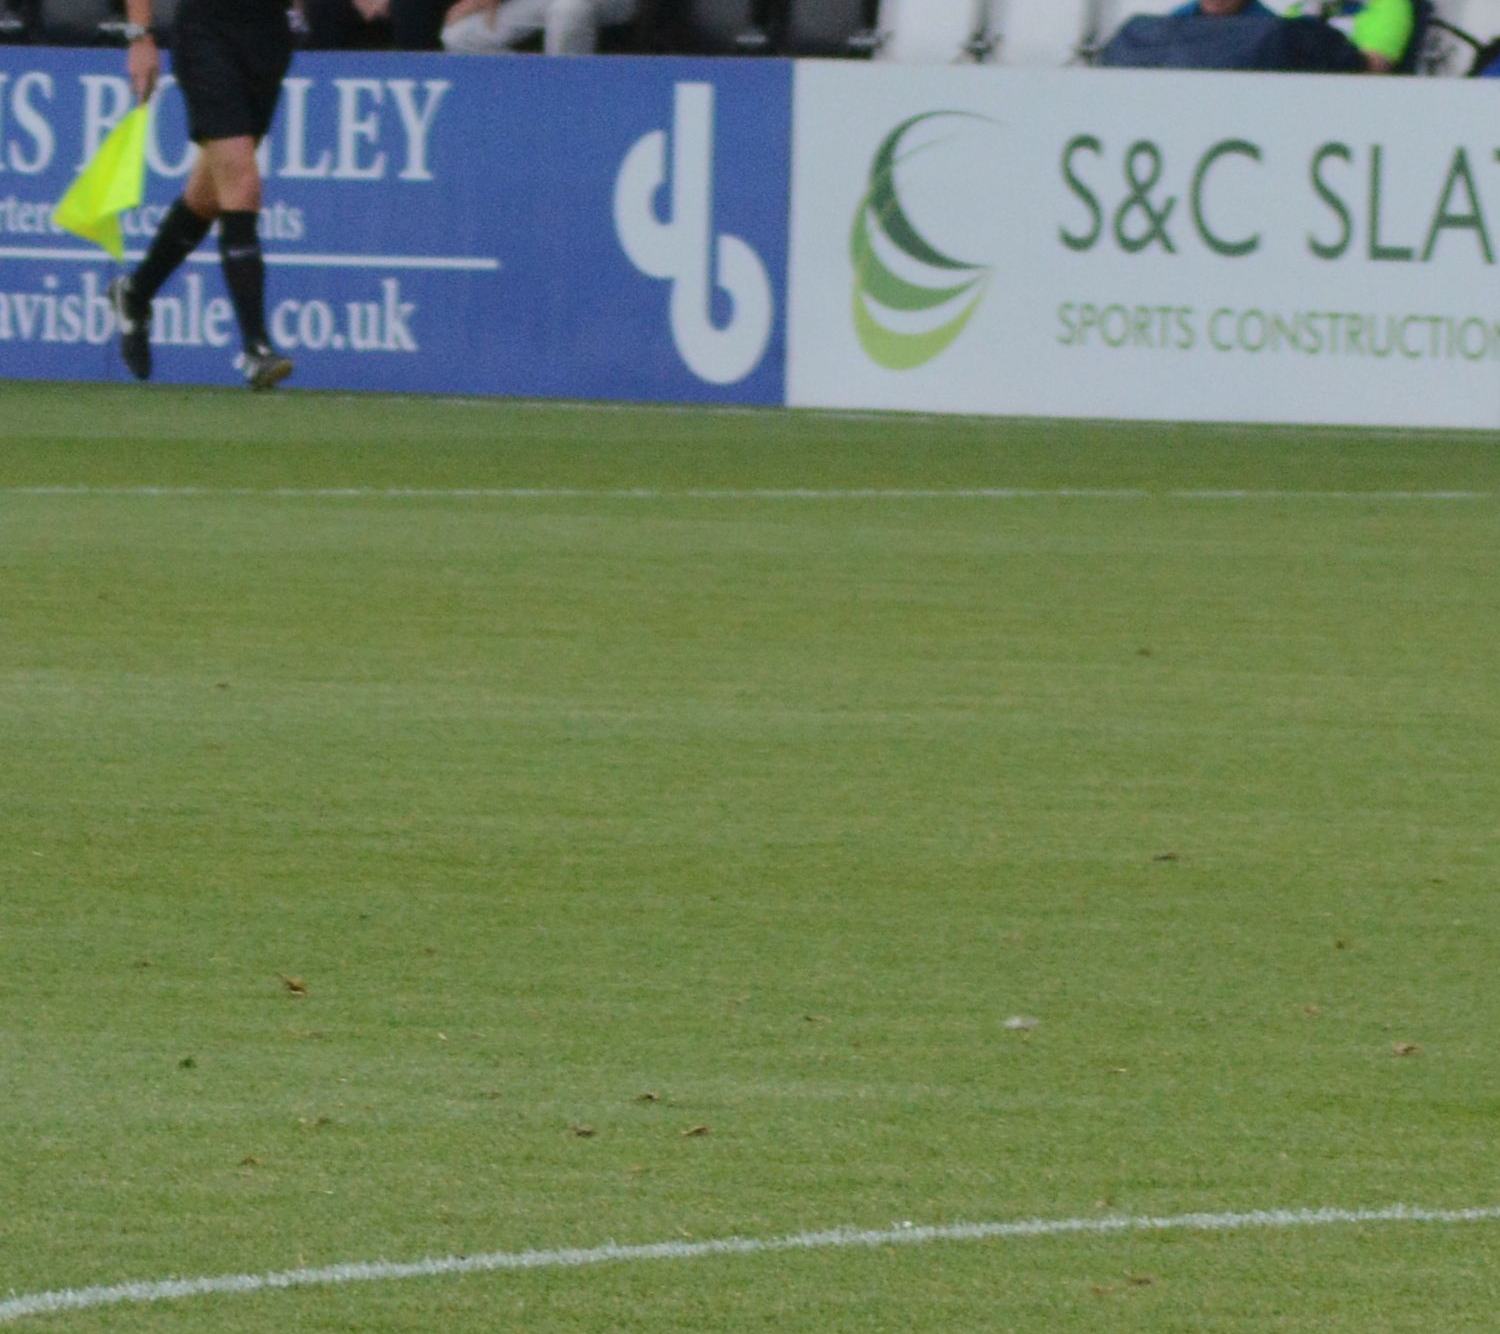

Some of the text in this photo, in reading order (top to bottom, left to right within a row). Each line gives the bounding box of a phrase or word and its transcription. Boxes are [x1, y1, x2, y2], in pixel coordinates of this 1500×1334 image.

[78, 73, 451, 182] BOLEY
[1057, 133, 1264, 258] S&C
[1056, 301, 1194, 351] SPORTS
